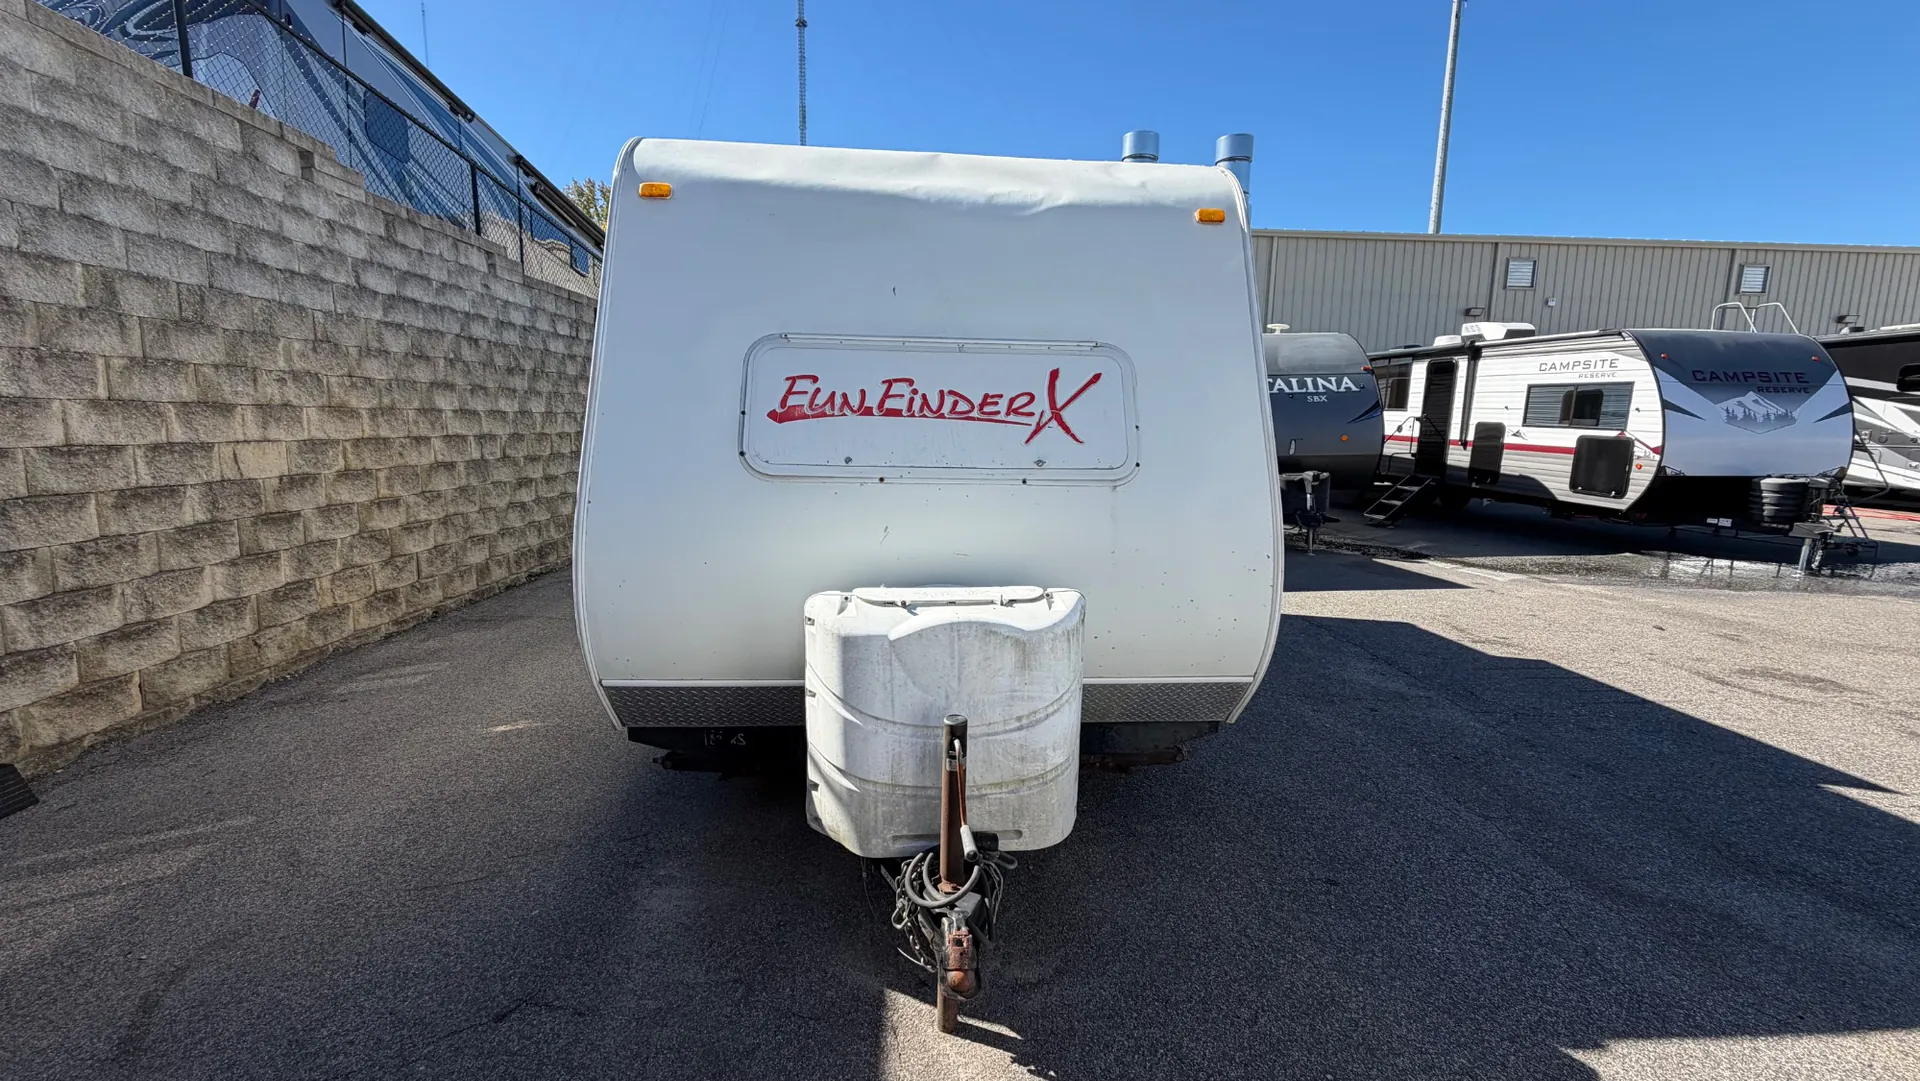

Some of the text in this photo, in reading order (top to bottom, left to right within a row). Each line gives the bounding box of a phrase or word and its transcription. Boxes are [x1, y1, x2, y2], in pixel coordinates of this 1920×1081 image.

[1538, 358, 1620, 372] CAMPSITE
[1578, 371, 1618, 379] RESERVE
[1691, 369, 1811, 384] CAMPSITE
[1757, 386, 1811, 394] RESERVE
[1307, 395, 1328, 403] SBX
[777, 374, 866, 415] FUN
[1023, 367, 1103, 445] X
